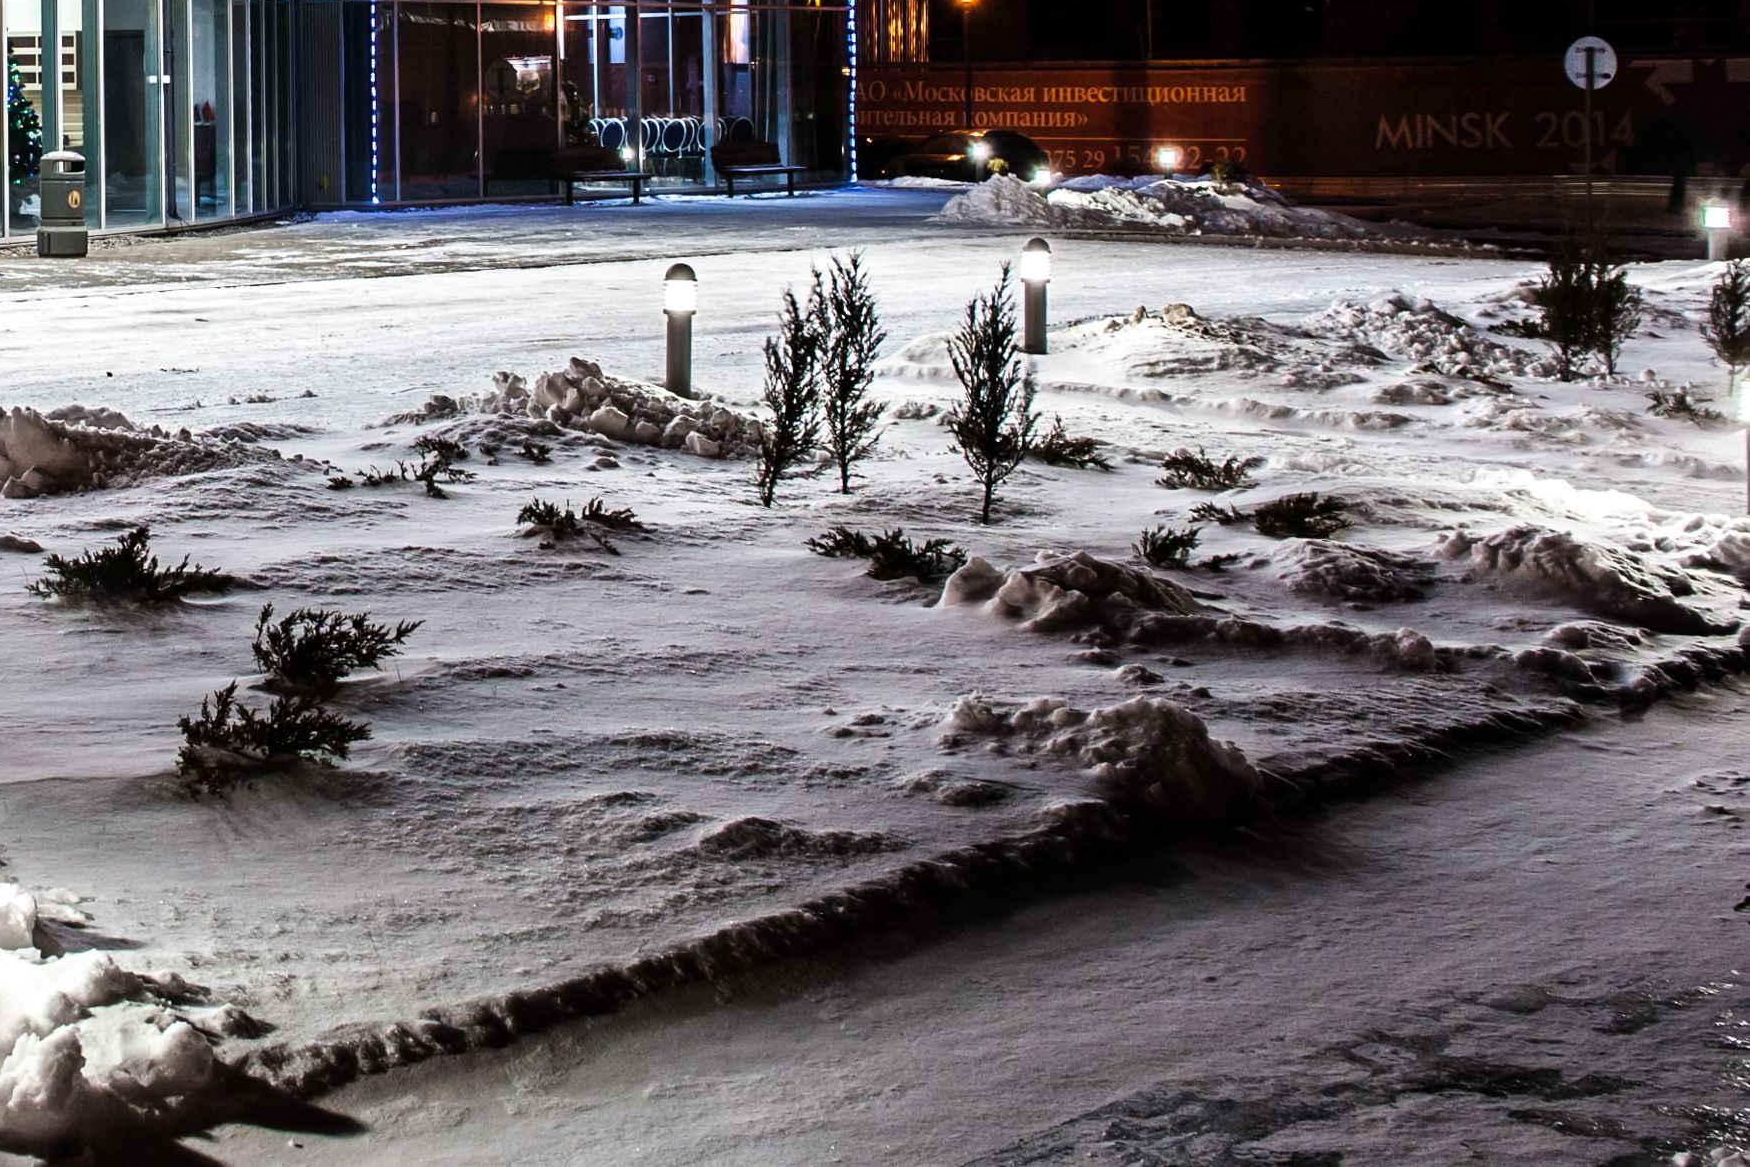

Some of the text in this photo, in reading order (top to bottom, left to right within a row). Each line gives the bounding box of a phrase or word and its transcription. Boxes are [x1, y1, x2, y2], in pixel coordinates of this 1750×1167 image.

[1042, 85, 1247, 106] инвестиционная
[1374, 110, 1637, 149] MINSK 2014
[1082, 149, 1106, 169] 29
